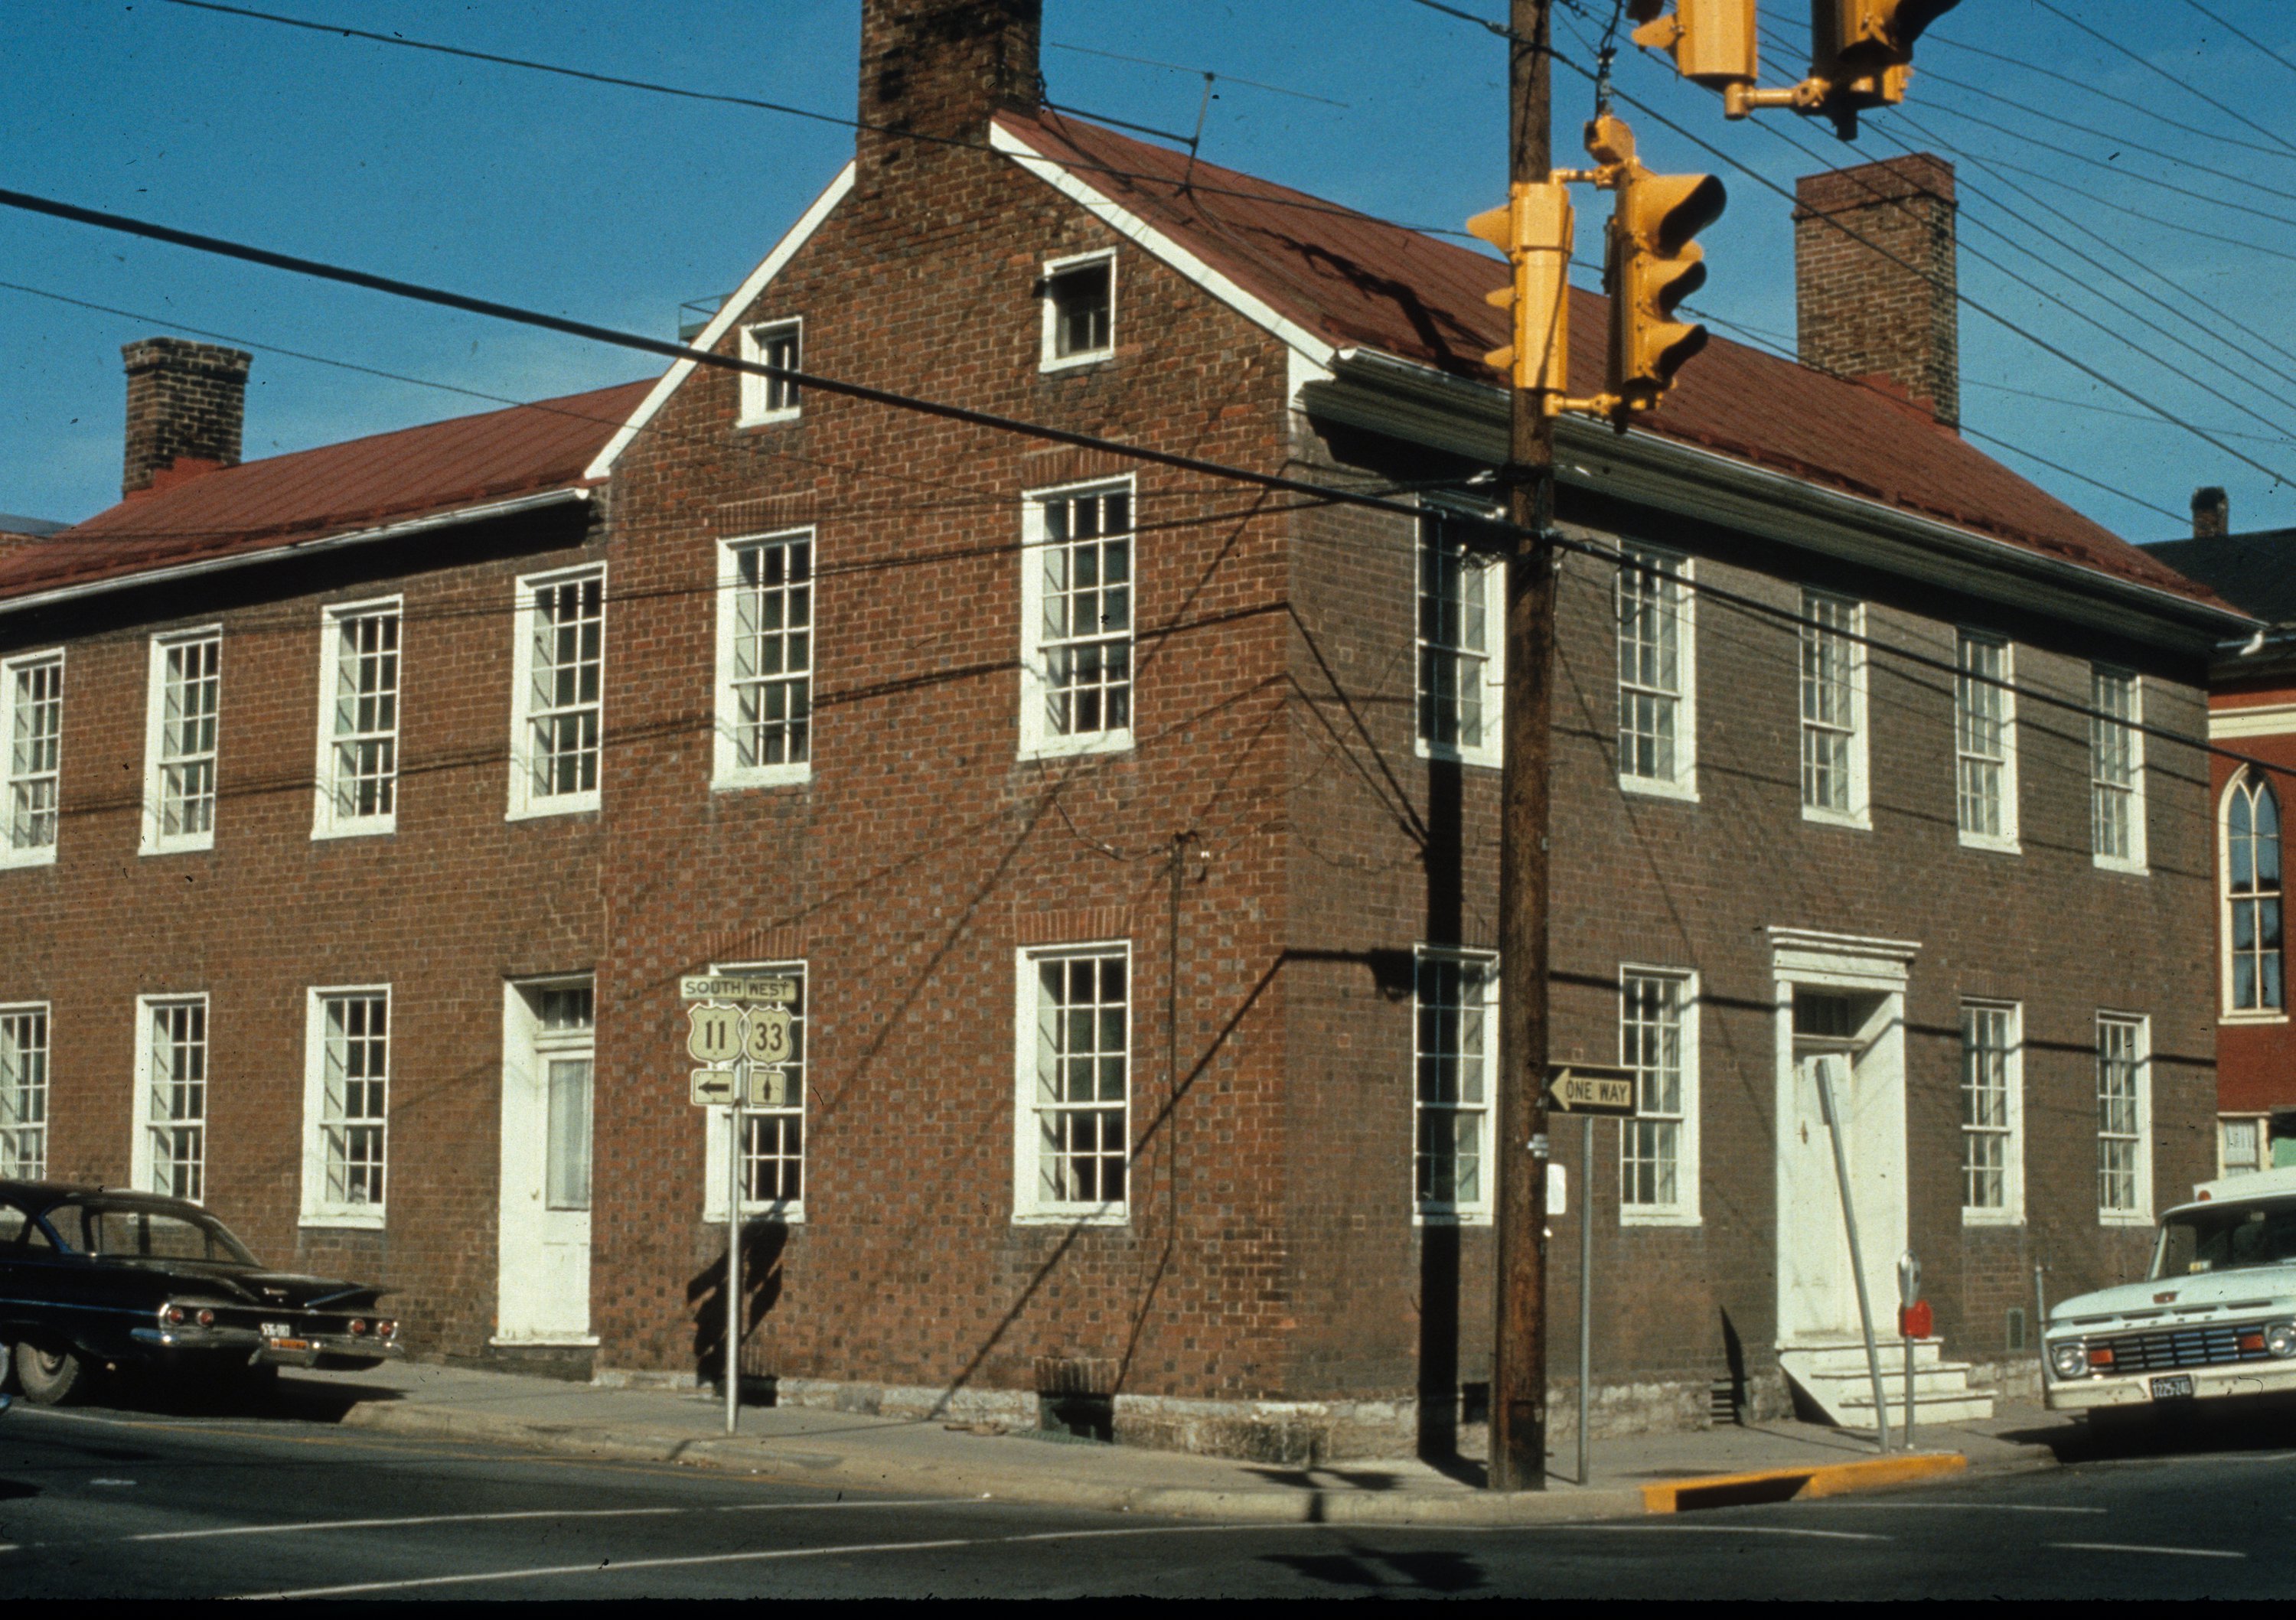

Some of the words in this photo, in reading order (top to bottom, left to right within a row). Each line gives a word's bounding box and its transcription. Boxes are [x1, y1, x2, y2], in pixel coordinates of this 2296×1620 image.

[685, 981, 742, 995] SOUTH
[748, 983, 788, 996] WEST
[706, 1019, 726, 1050] 11
[755, 1022, 783, 1051] 33
[1566, 1081, 1592, 1100] ONE
[1600, 1083, 1627, 1101] WAY
